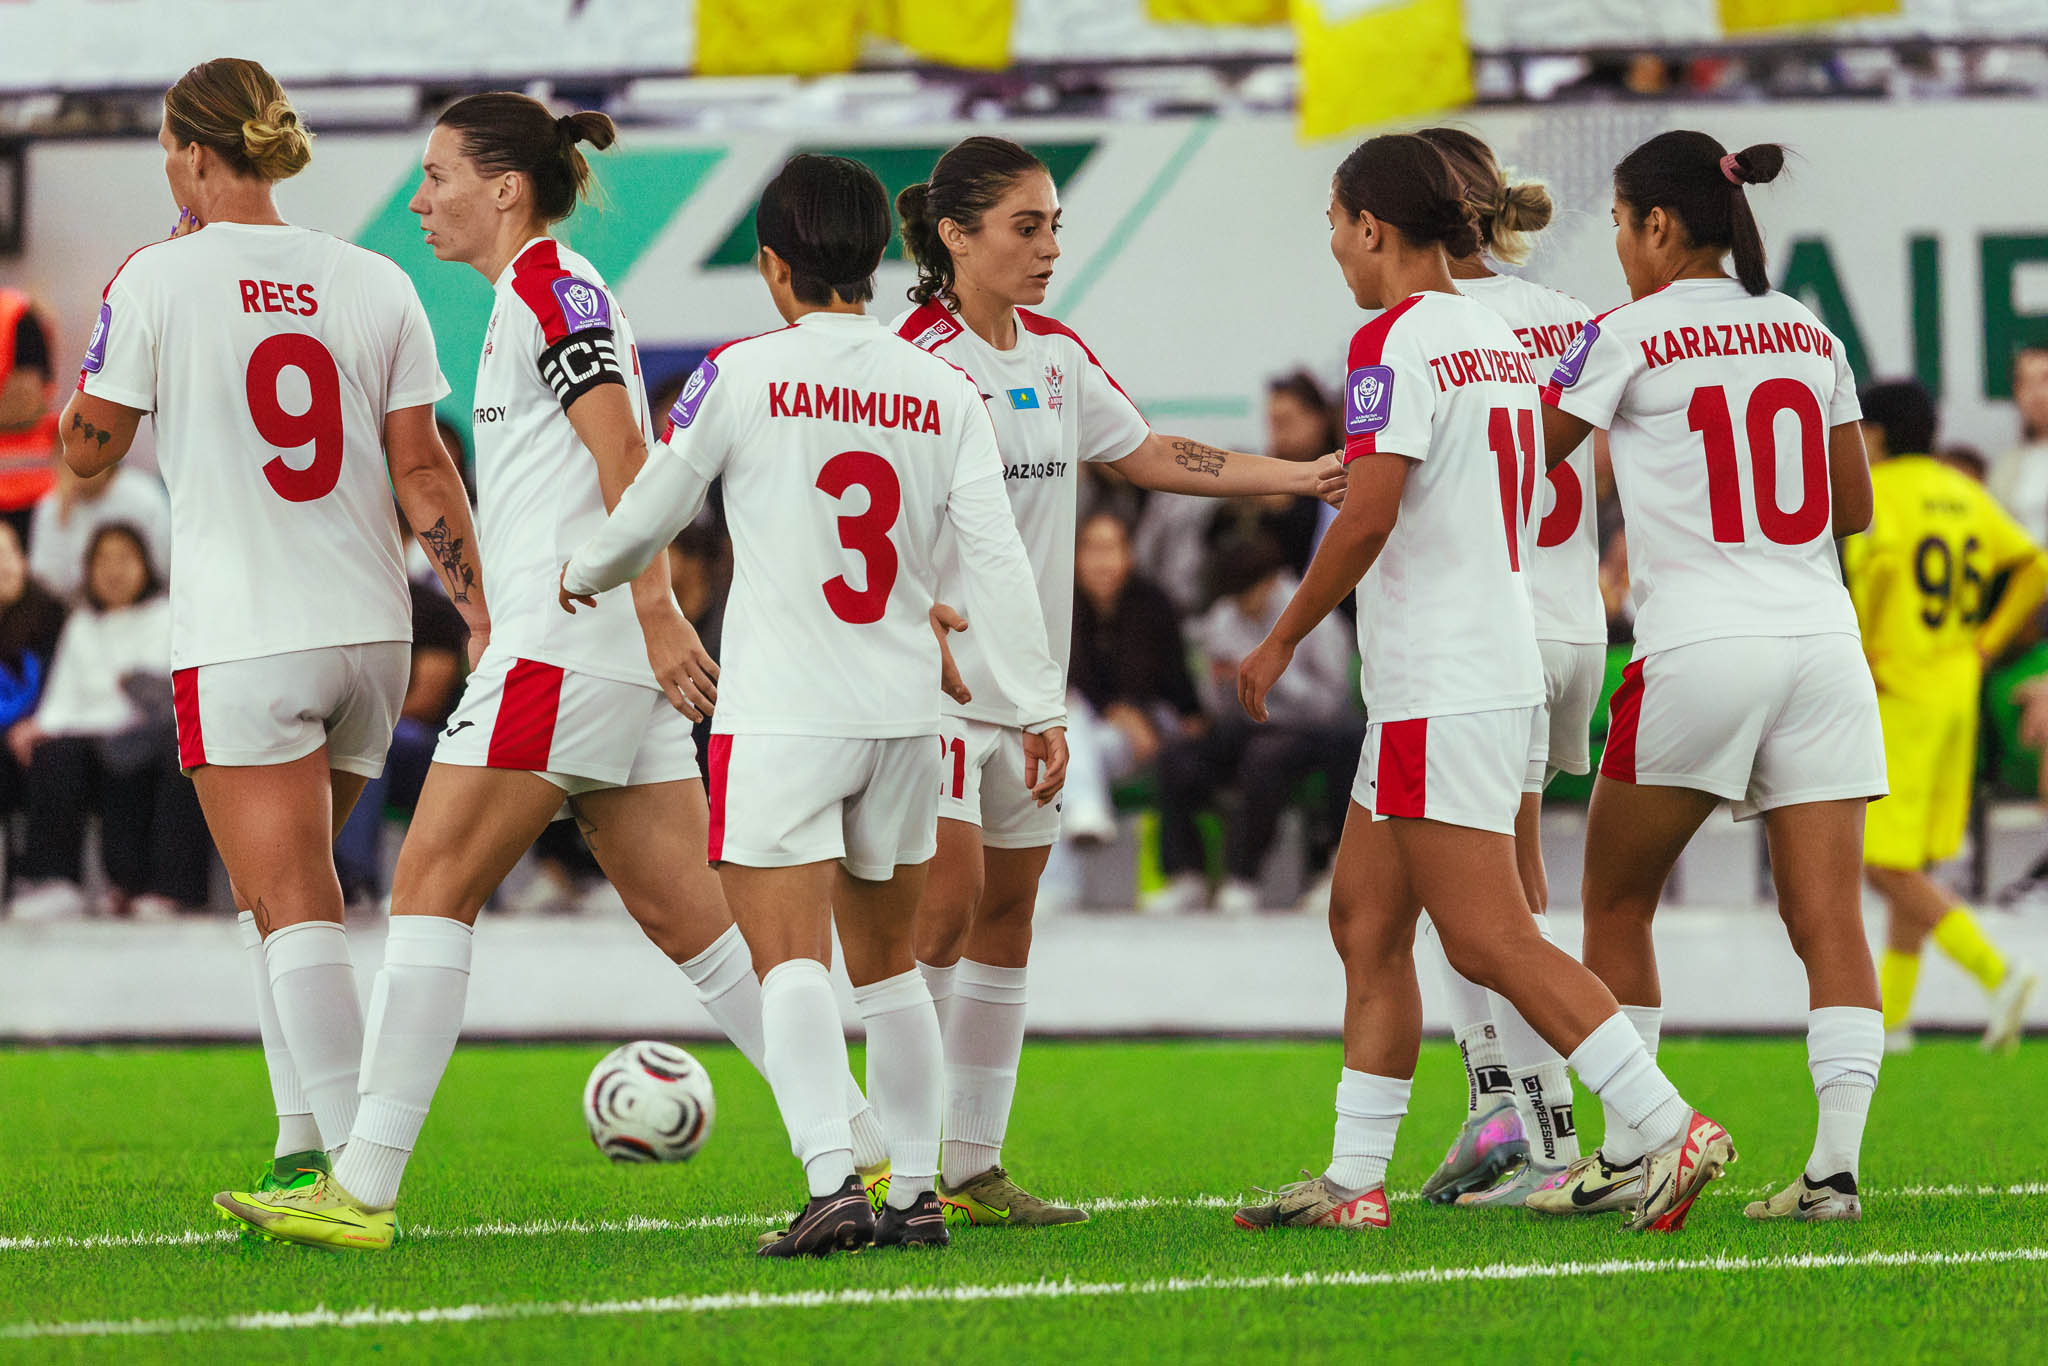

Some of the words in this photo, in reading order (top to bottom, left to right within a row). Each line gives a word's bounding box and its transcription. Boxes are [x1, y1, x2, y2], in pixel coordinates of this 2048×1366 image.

[239, 279, 319, 317] REES
[1640, 322, 1833, 369] KARAZHANOVA
[246, 333, 344, 503] 9
[474, 406, 507, 427] TROY
[769, 382, 941, 436] KAMIMURA
[1488, 407, 1536, 572] 11
[1687, 378, 1830, 545] 10
[815, 451, 901, 624] 3
[1529, 1091, 1556, 1160] TAPEDESIGN
